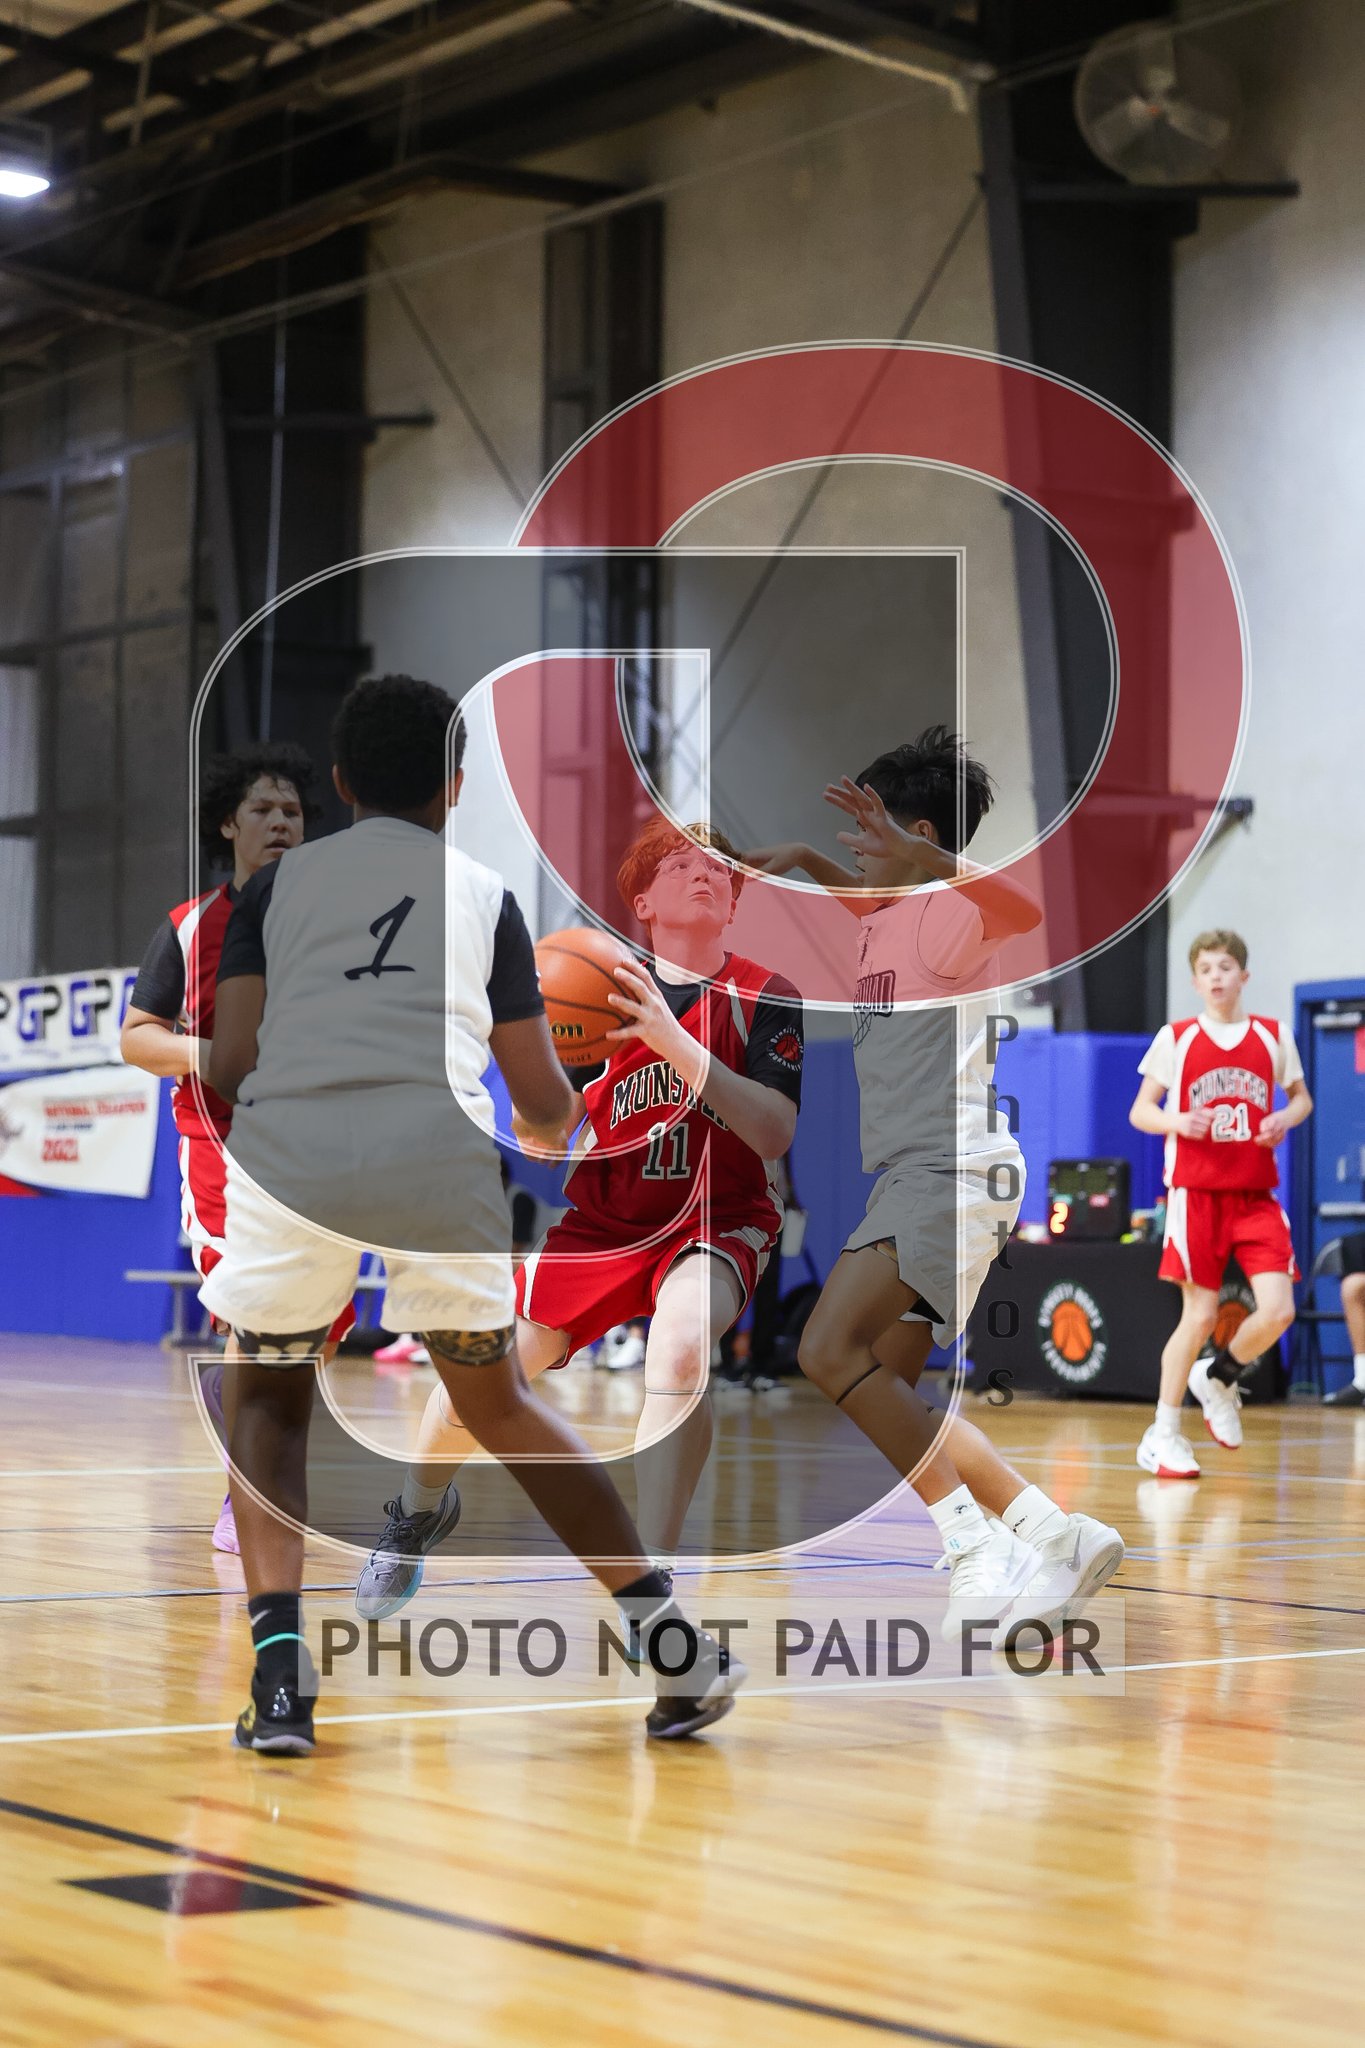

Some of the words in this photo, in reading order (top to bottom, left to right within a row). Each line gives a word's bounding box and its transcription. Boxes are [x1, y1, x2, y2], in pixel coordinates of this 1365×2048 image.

[343, 896, 416, 980] 1
[1188, 1066, 1269, 1112] MUNSTER
[1211, 1102, 1252, 1142] 21
[641, 1121, 691, 1180] 11
[1050, 1202, 1068, 1234] 2
